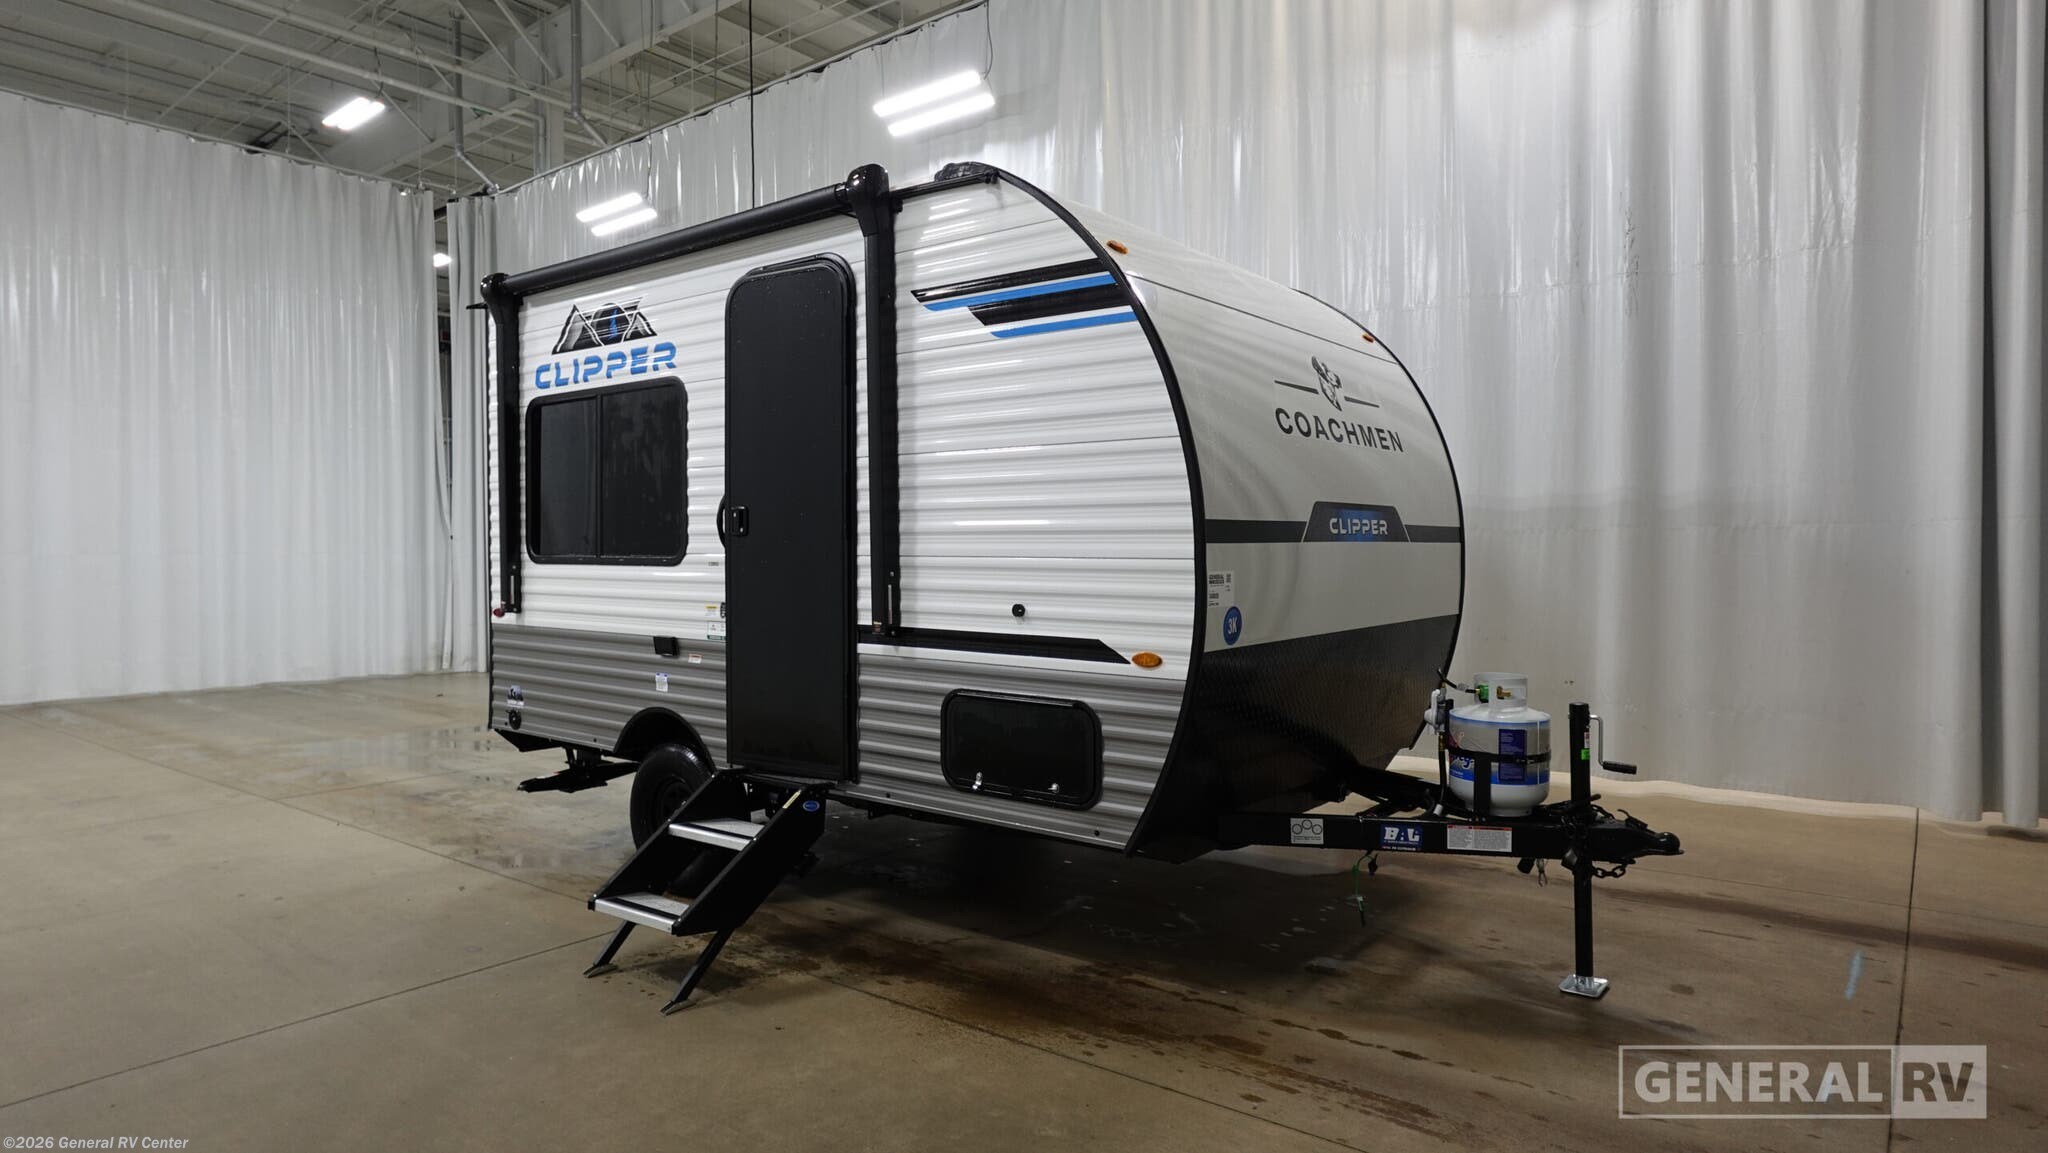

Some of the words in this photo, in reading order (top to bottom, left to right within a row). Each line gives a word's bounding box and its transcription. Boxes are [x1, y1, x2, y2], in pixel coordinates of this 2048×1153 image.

[535, 341, 677, 390] CLIPPER
[1275, 407, 1403, 452] COACHMEN
[1329, 518, 1388, 535] CLIPPER
